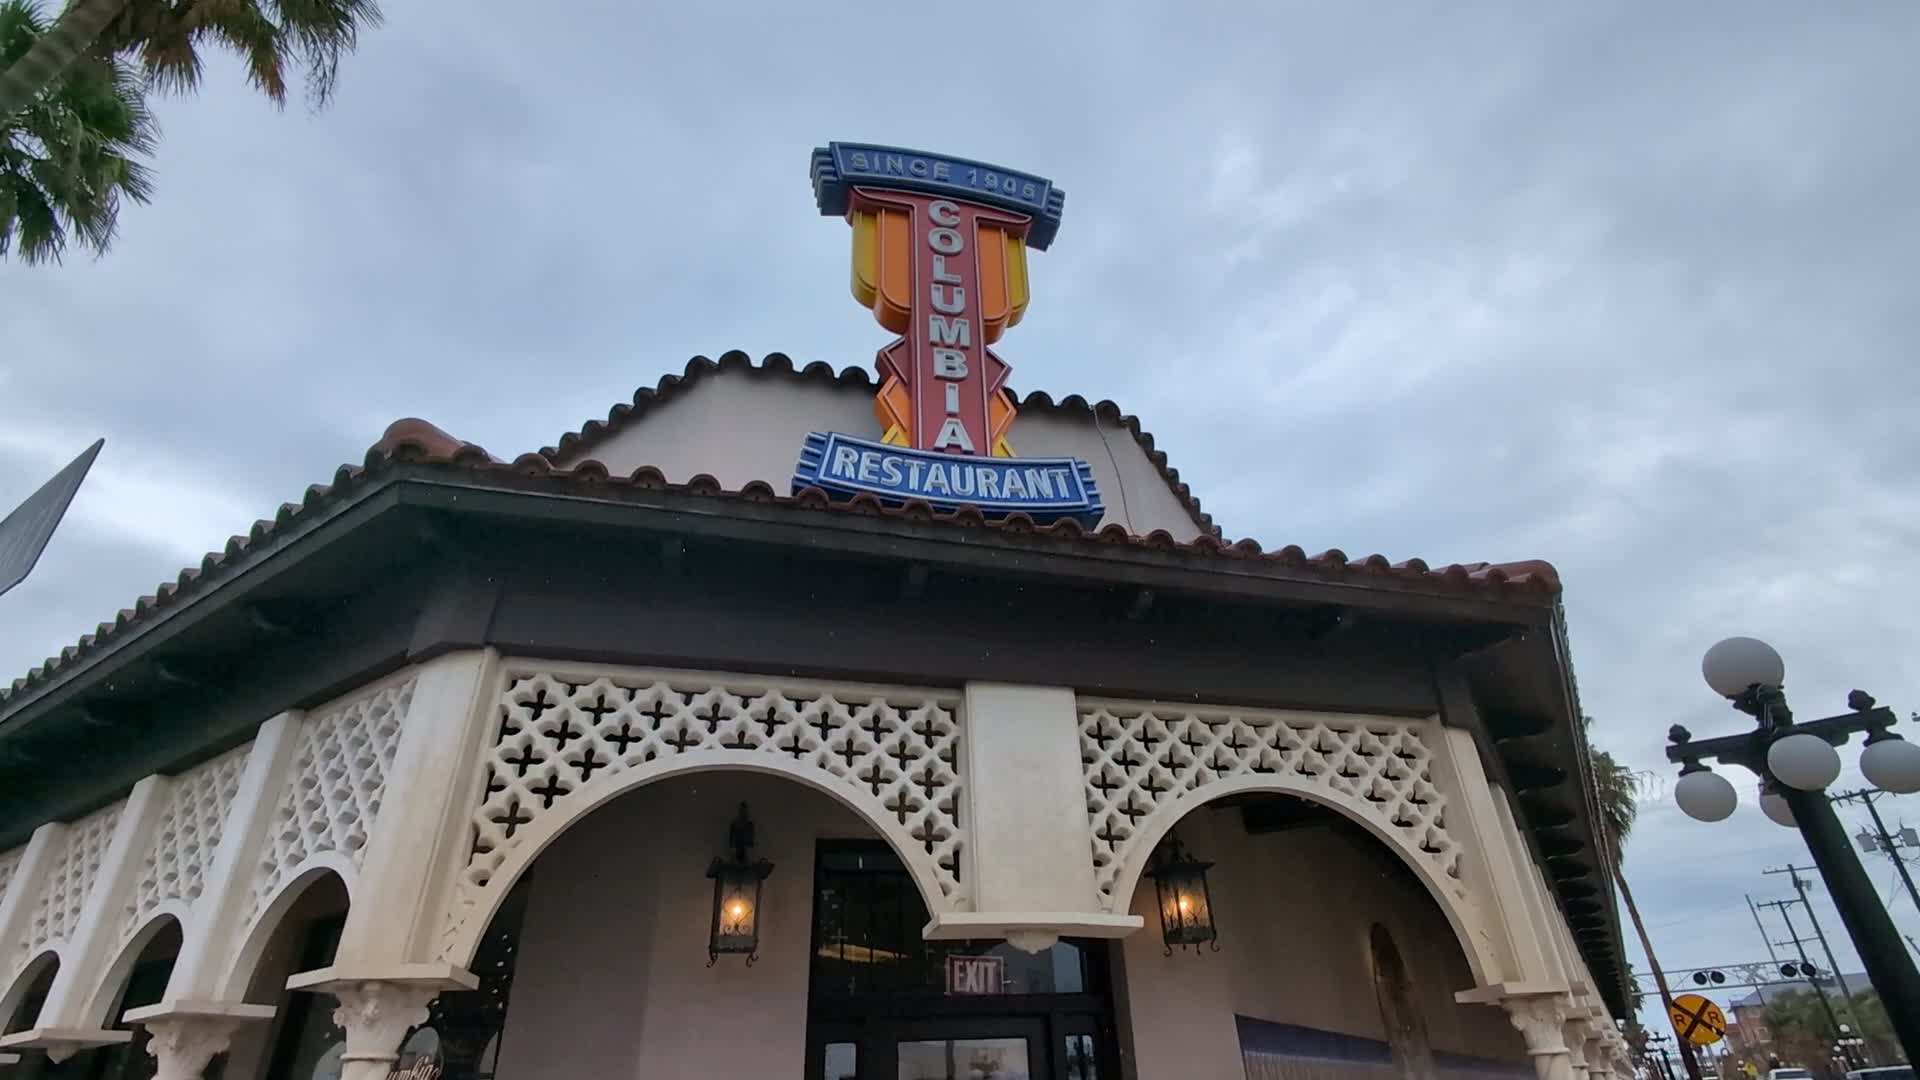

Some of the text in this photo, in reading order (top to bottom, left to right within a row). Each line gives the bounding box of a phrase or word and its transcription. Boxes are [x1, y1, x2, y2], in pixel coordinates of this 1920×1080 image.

[850, 152, 1036, 200] SINCE 1905
[928, 200, 975, 455] COLUMBIA
[831, 446, 1070, 499] RESTAURANT
[954, 960, 997, 993] EXIT
[1673, 1011, 1722, 1026] R R
